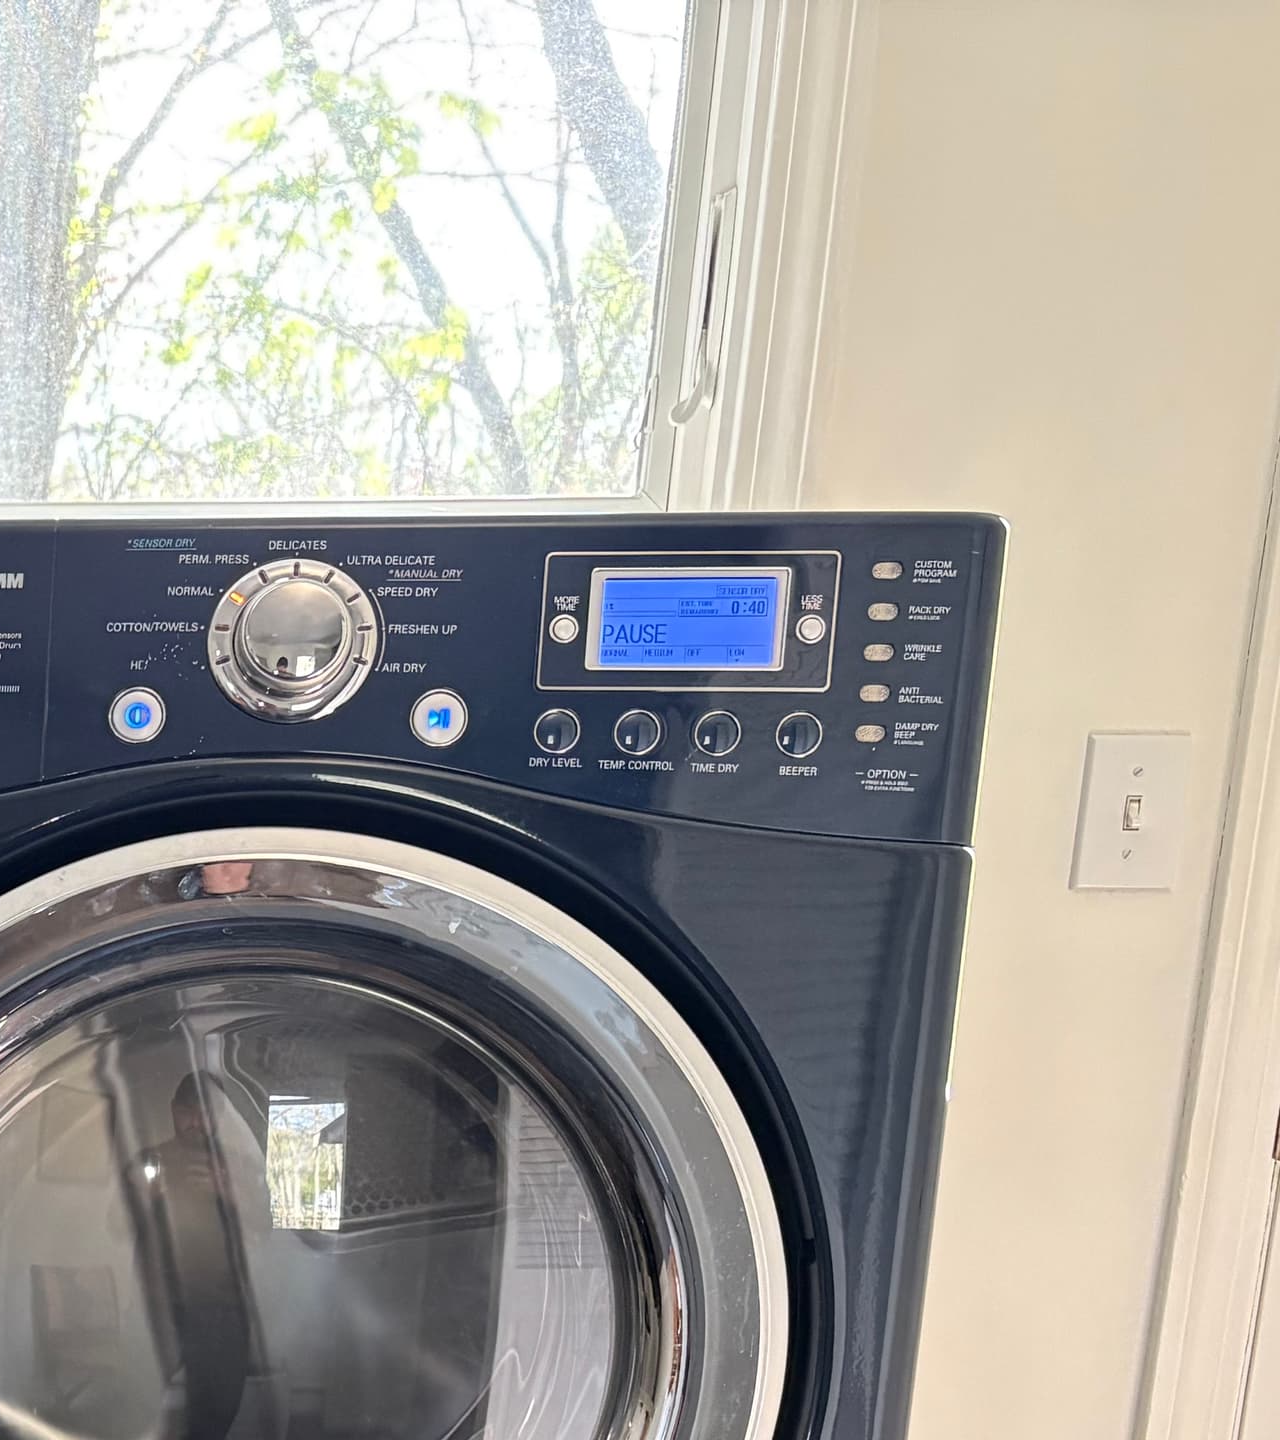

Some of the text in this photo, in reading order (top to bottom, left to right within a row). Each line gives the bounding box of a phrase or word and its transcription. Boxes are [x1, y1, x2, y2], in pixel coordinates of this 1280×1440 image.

[175, 538, 196, 548] DRY
[268, 540, 328, 550] DELICATES
[179, 554, 250, 565] PERM. PRESS
[347, 555, 436, 566] ULTRA DELICATE
[914, 560, 953, 569] CUSTOM
[441, 569, 464, 579] DRY
[913, 569, 958, 578] PROGRAM
[167, 586, 215, 597] NORMAL
[376, 586, 439, 597] SPEED DRY
[553, 595, 580, 604] MORE
[801, 594, 823, 604] LESS
[731, 600, 765, 614] 0:40
[908, 605, 952, 615] RACK DRY
[106, 621, 199, 632] COTTON/TOWELS
[388, 623, 458, 635] FRESHEN UP
[602, 624, 668, 644] PAUSE
[904, 644, 943, 653] WRINKLE
[903, 652, 927, 661] CARE
[381, 662, 427, 673] AIR DRY
[899, 686, 920, 695] ANTI
[898, 695, 944, 704] BACTERIAL
[895, 722, 940, 731] DAMP DRY
[894, 730, 916, 739] BEEP
[528, 757, 583, 768] DRY LEVEL
[598, 759, 675, 771] TEMP. CONTROL
[690, 762, 740, 773] TIME DRY
[778, 765, 819, 777] BEEPER
[867, 769, 907, 780] OPTION
